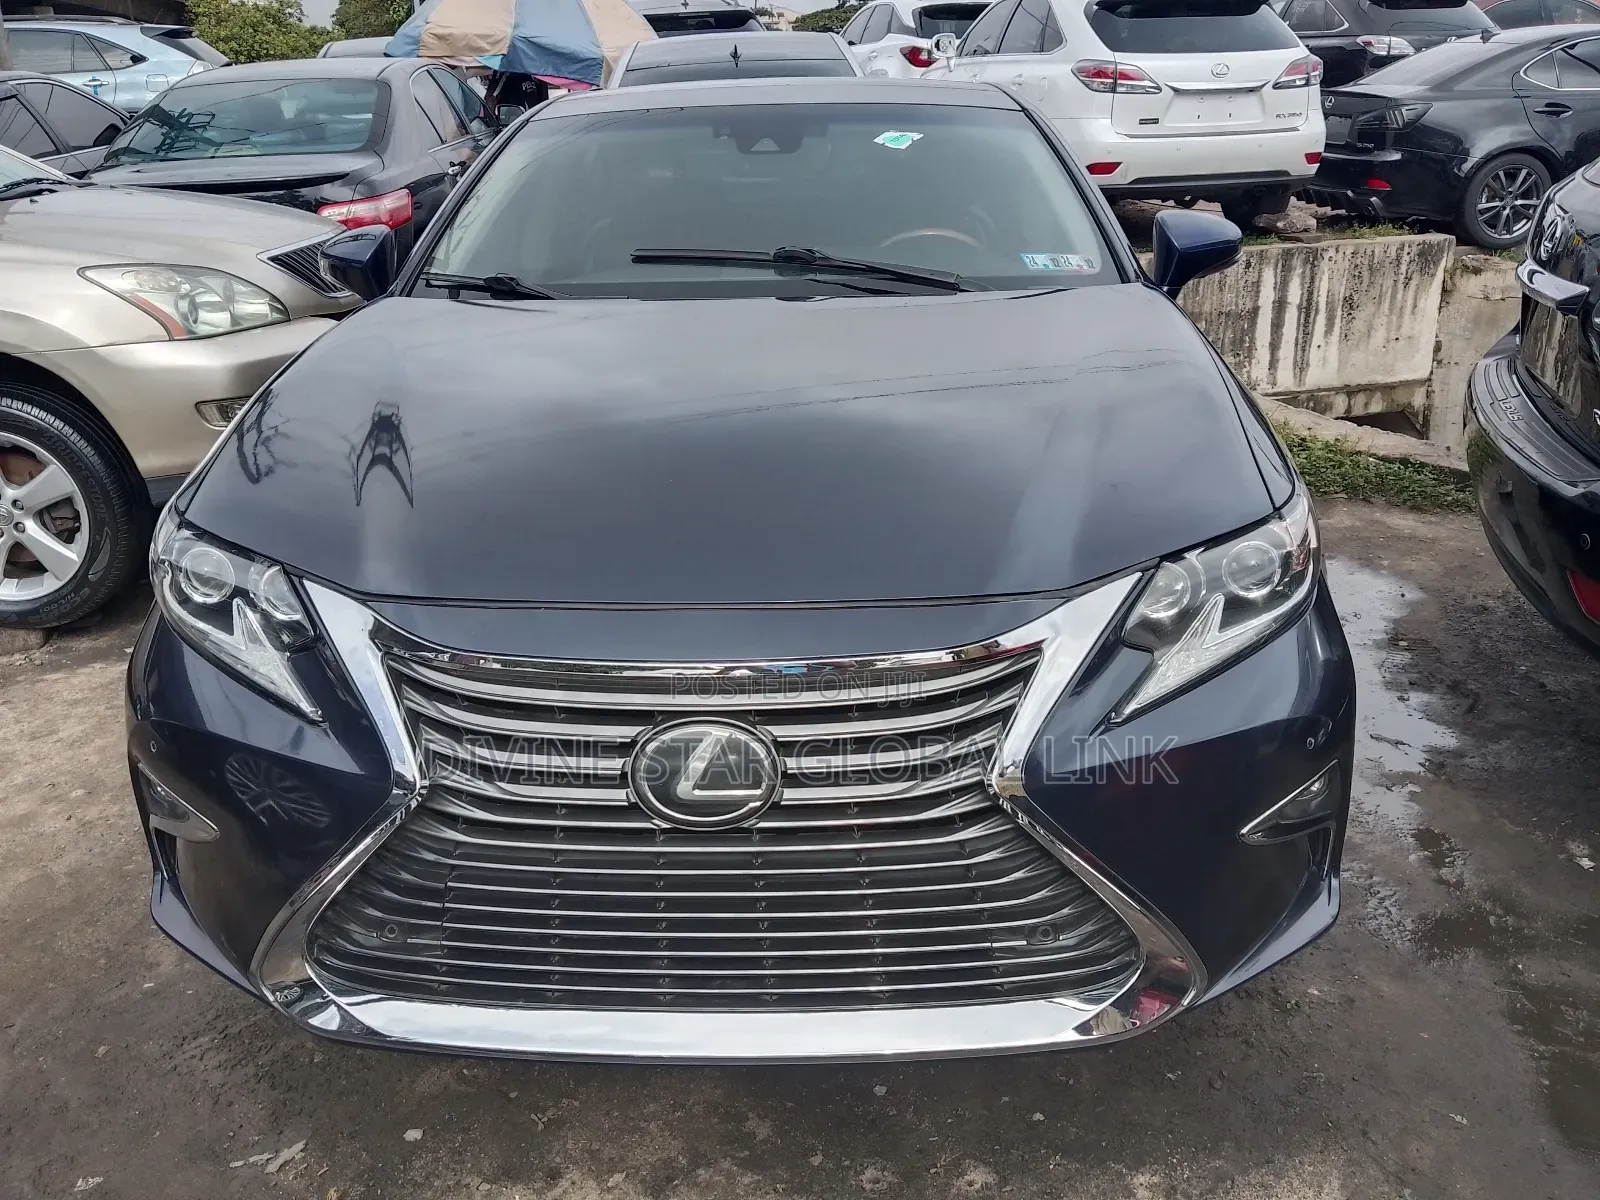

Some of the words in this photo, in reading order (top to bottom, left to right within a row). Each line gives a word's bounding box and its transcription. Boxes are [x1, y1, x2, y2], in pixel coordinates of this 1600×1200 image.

[1026, 255, 1039, 267] 24
[1061, 255, 1074, 267] 24
[1500, 401, 1523, 422] LEXUS
